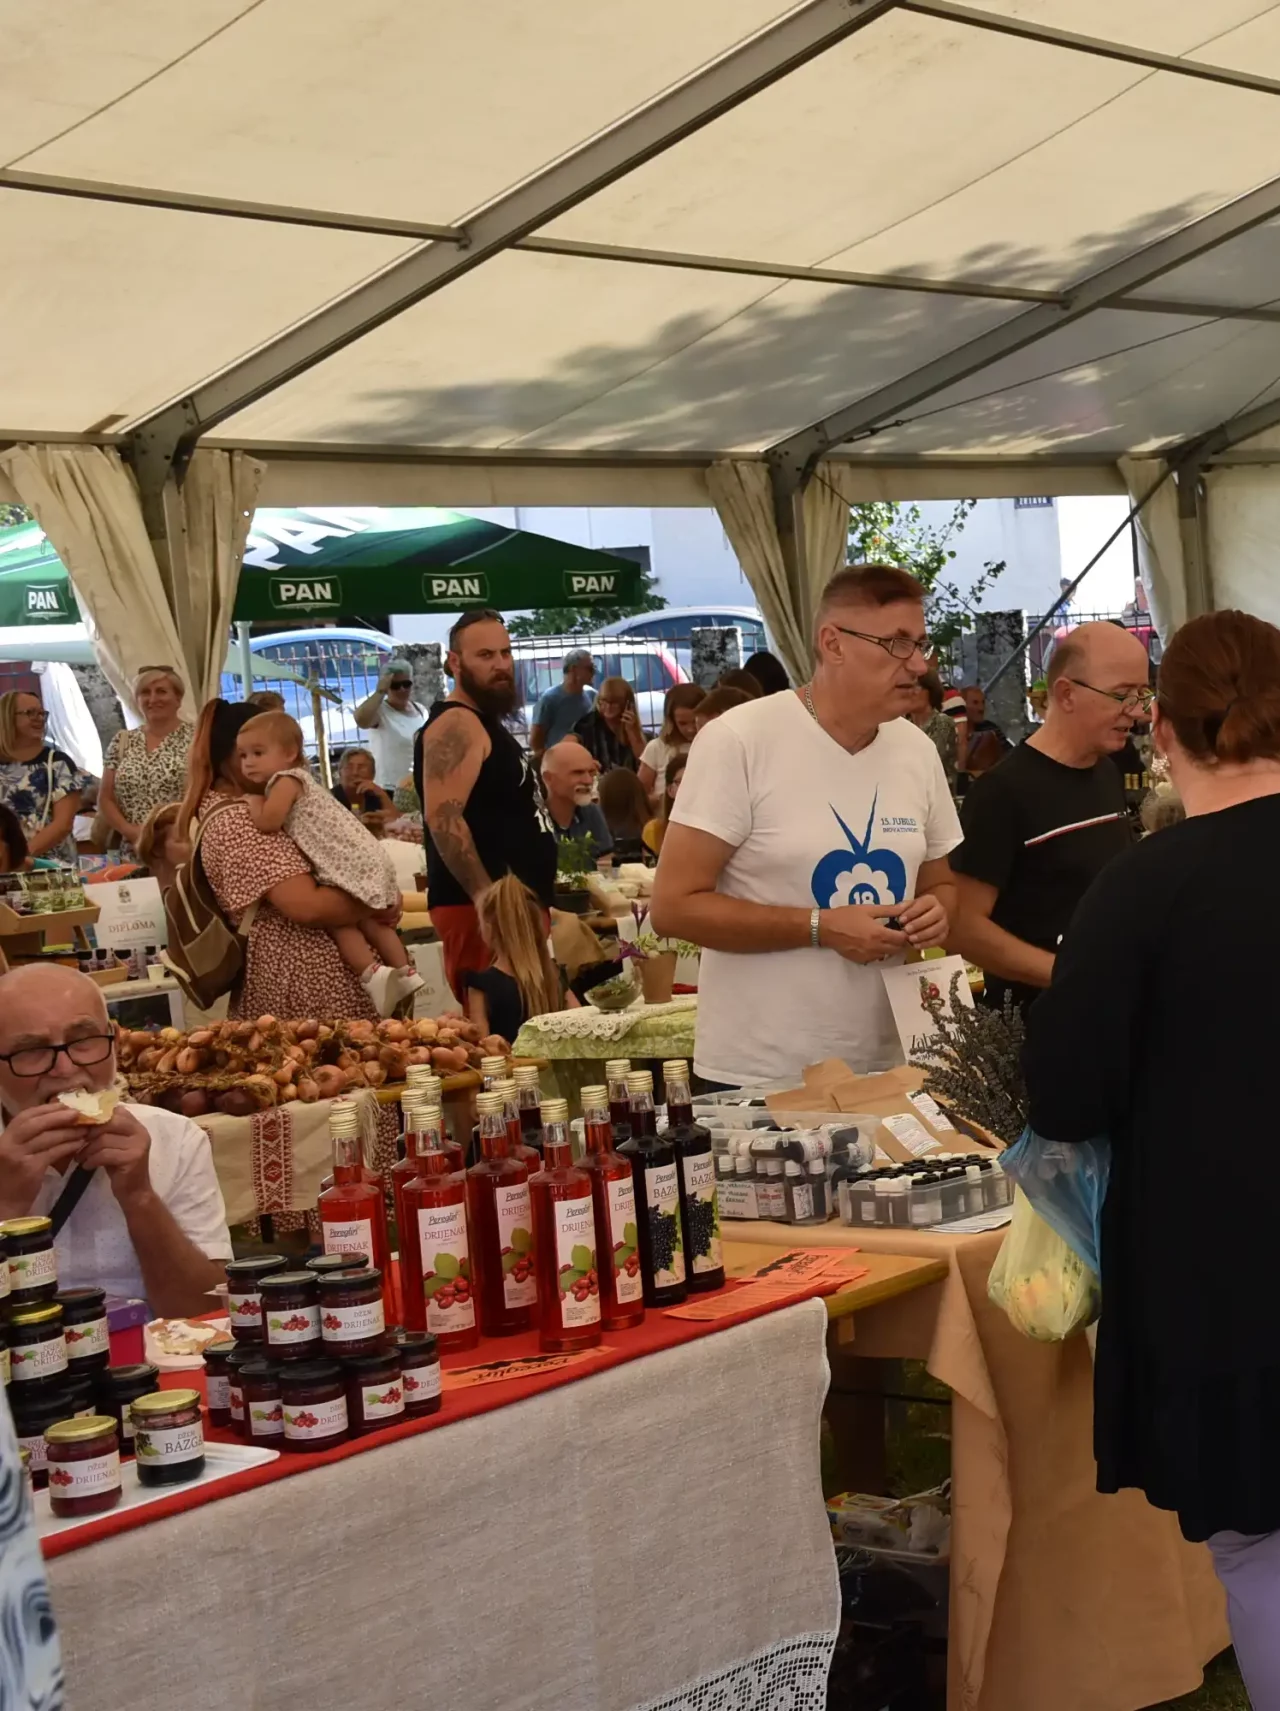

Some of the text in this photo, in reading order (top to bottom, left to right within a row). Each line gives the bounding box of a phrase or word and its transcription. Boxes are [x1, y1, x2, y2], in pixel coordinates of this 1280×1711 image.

[279, 582, 333, 602] PAN
[431, 578, 481, 597] PAN
[572, 575, 615, 592] PAN
[27, 591, 60, 610] PAN
[108, 920, 156, 933] DIPLOMA
[691, 1172, 715, 1186] BAZG
[654, 1184, 678, 1198] BAZG
